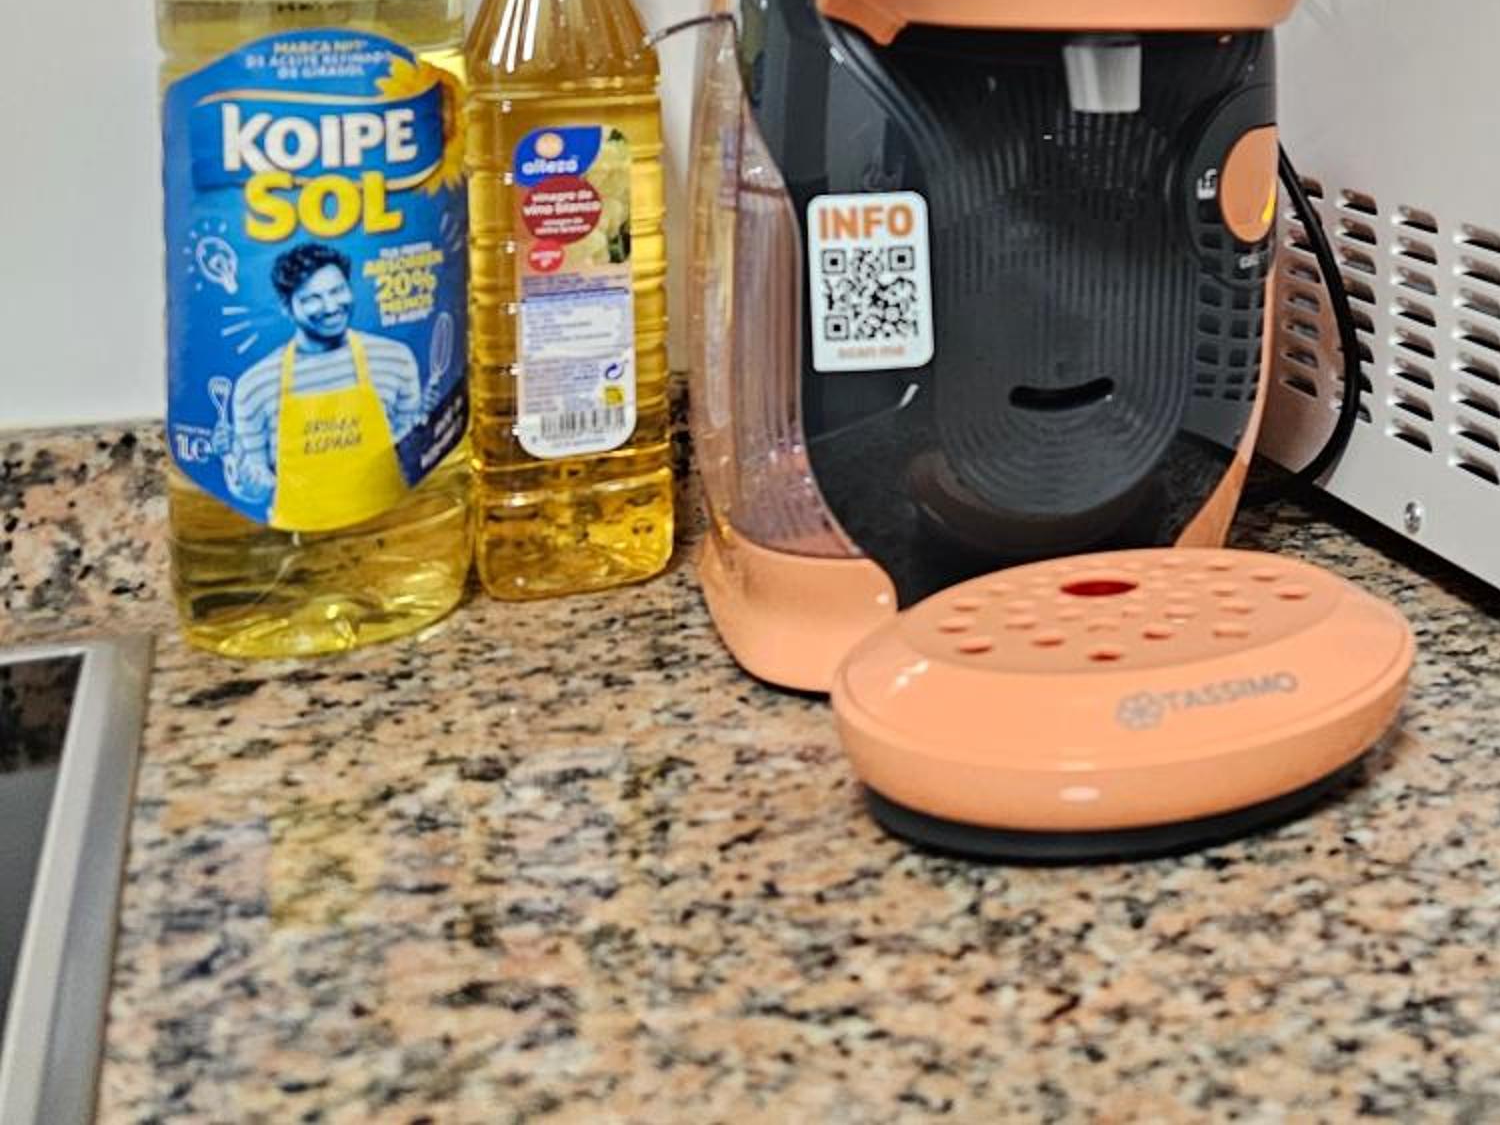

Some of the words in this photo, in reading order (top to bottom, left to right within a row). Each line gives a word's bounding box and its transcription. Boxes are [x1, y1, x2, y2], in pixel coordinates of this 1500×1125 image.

[221, 103, 418, 173] KOIPE
[244, 171, 403, 242] SOL
[818, 204, 914, 240] INFO
[1159, 671, 1299, 712] TASSIMO
